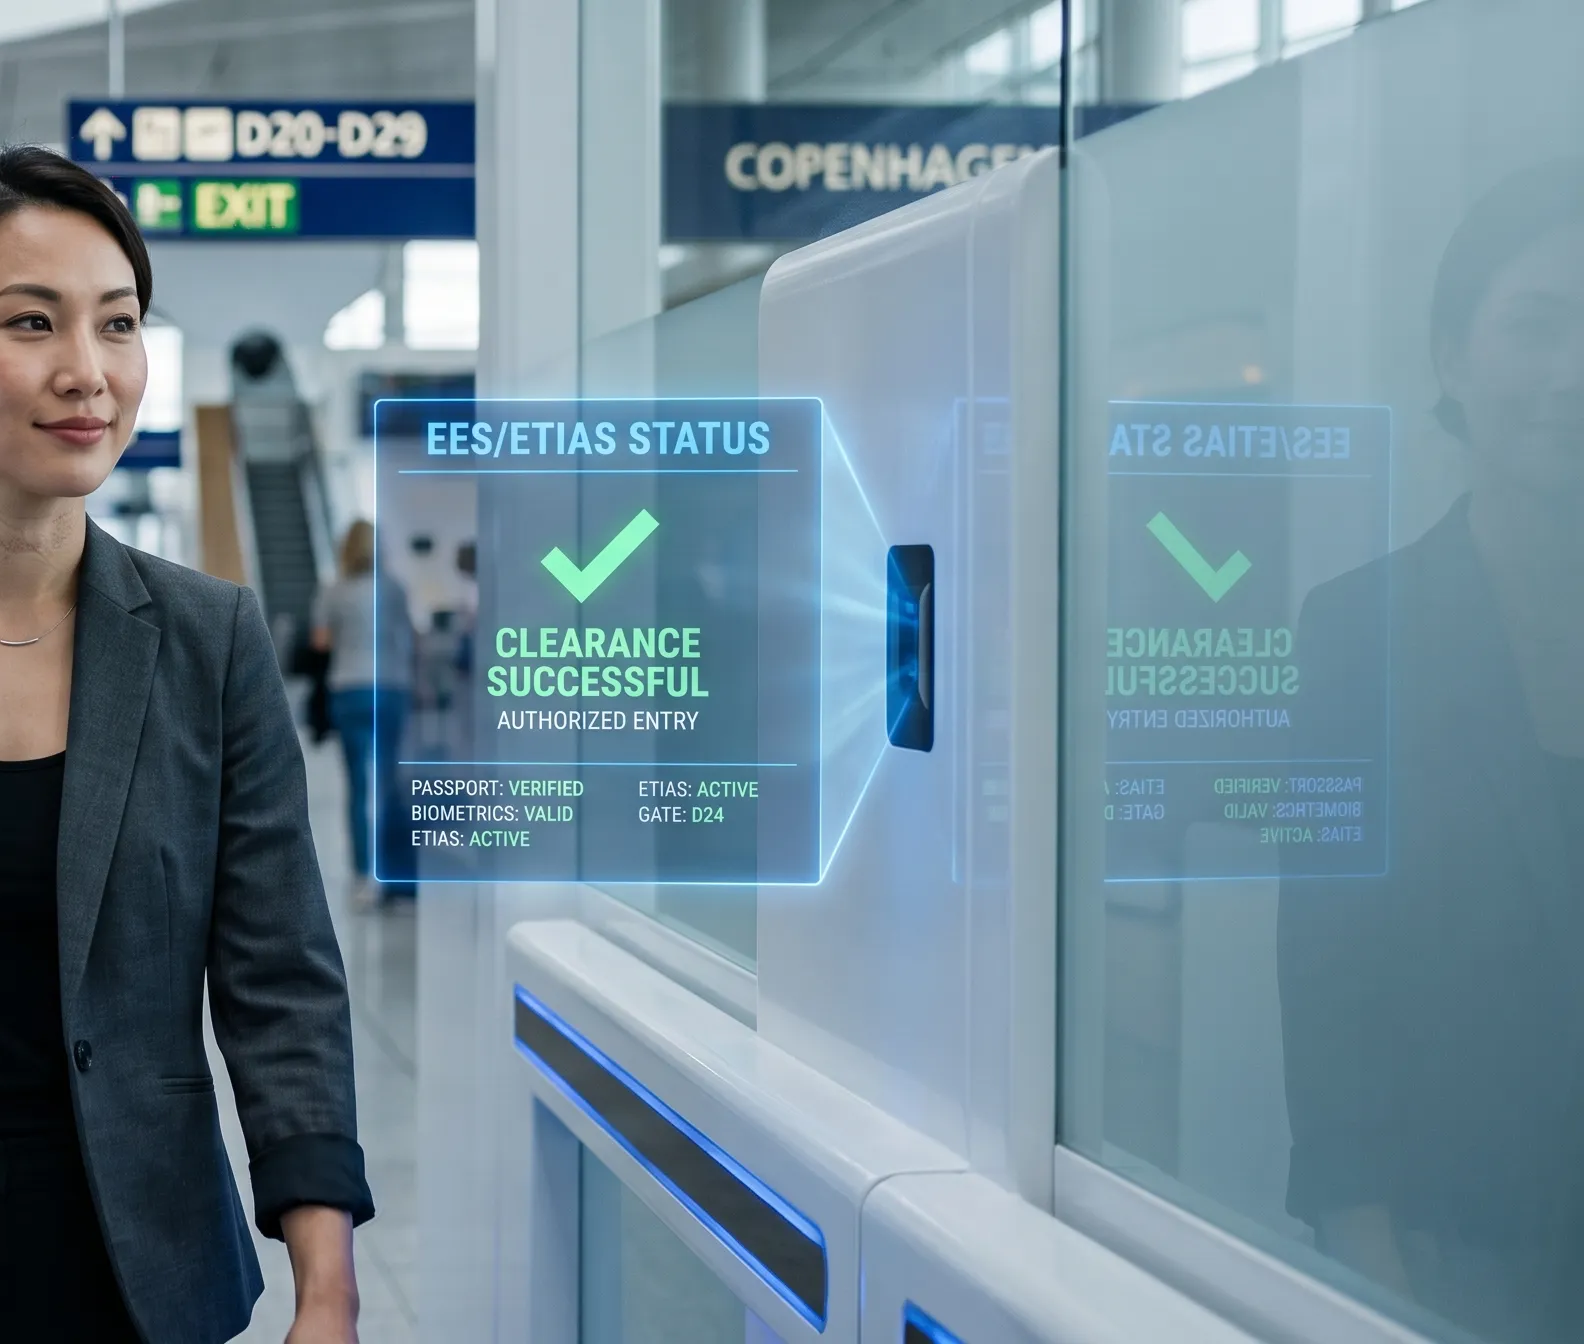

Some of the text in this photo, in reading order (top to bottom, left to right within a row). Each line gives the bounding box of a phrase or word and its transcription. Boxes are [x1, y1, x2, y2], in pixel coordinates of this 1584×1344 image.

[235, 109, 428, 158] D20-D29
[724, 142, 1052, 191] COPENHAG
[195, 182, 296, 230] EXIT
[427, 420, 771, 457] EES/ETIAS STATUS
[495, 627, 701, 659] CLEARANCE
[487, 665, 710, 698] SUCCESSFUL
[497, 710, 700, 731] AUTHORIZED ENTRY
[411, 779, 584, 798] PASSPORT: VERIFIED
[638, 780, 759, 798] ETIAS: ACTIVE
[411, 805, 574, 823] BIOMETRICS: VALID
[638, 806, 725, 823] GATE: D24
[411, 830, 531, 848] ETIAS: ACTIVE
